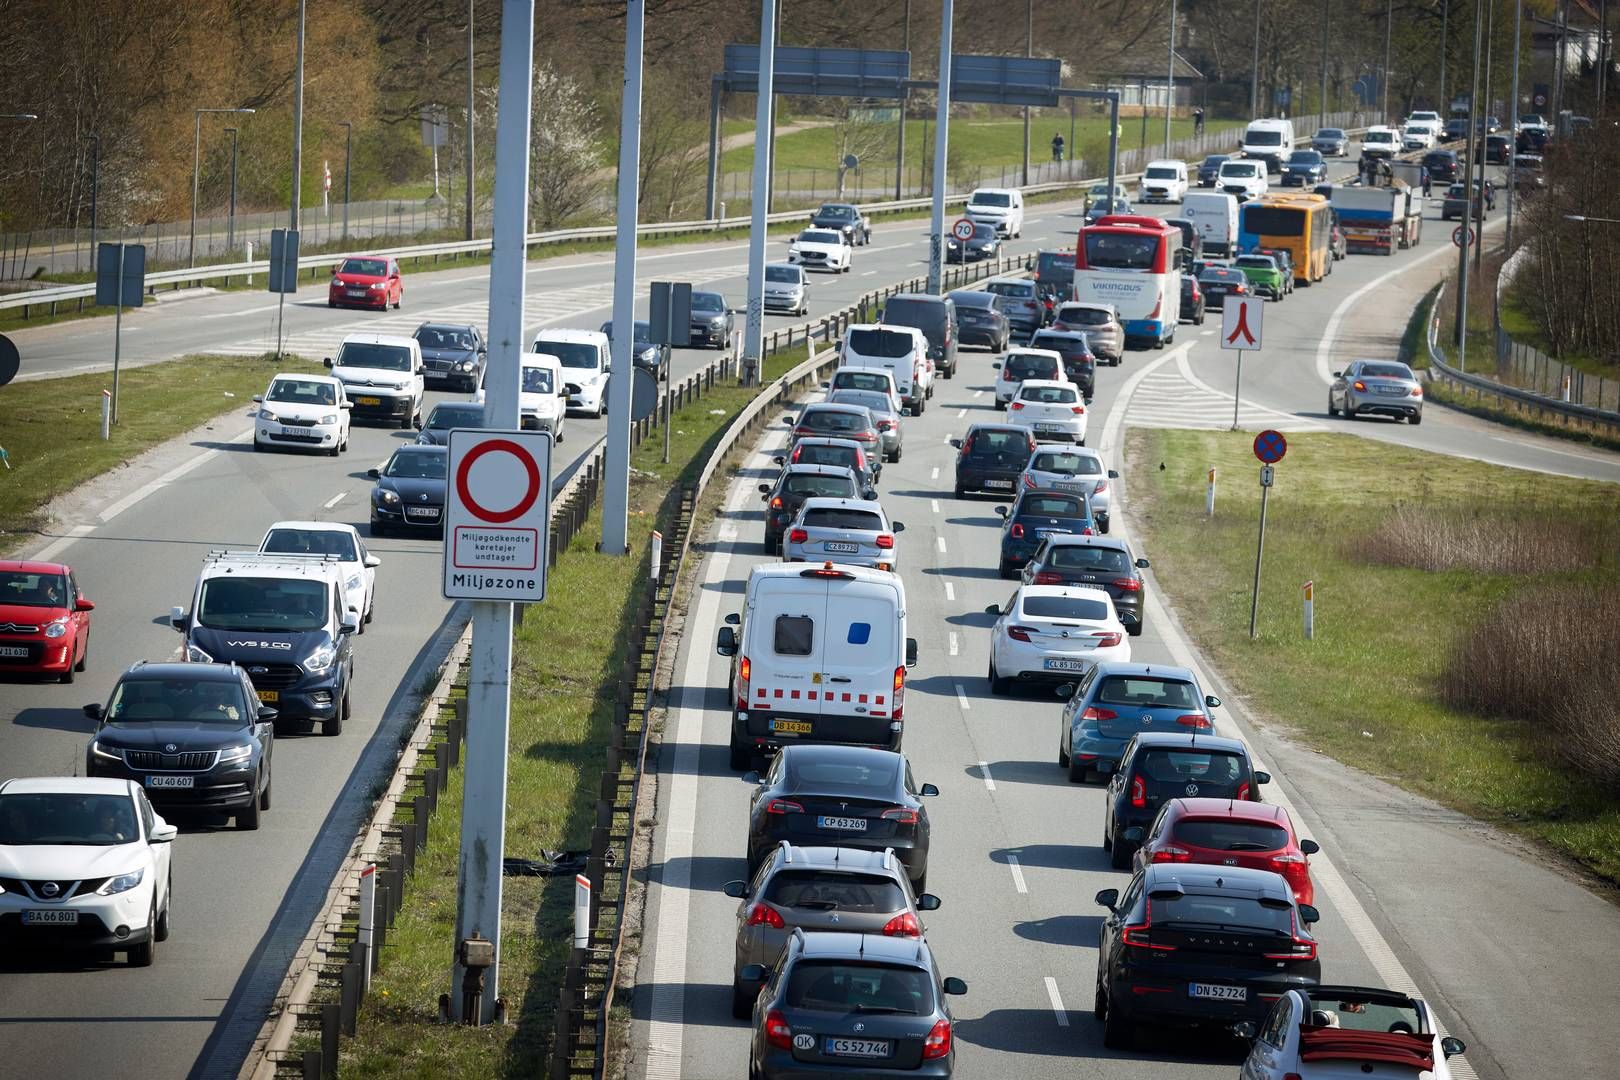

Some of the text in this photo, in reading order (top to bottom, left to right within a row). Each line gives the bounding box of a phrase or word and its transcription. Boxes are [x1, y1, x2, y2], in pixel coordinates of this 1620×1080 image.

[956, 226, 971, 235] 70
[462, 533, 530, 543] Miljøgodkendte
[475, 543, 516, 552] køretøjer
[475, 554, 515, 562] undtaget
[453, 574, 536, 590] Miljøzone
[14, 648, 27, 656] 630
[263, 692, 277, 700] 541
[786, 722, 795, 730] 14
[796, 723, 811, 731] 366
[152, 777, 193, 786] CU 40 607
[824, 818, 866, 828] CP 63 269
[29, 912, 75, 921] BA 66 801
[1196, 985, 1245, 998] DN 52 724
[797, 1037, 812, 1048] DK
[834, 1041, 887, 1054] CS 52 744
